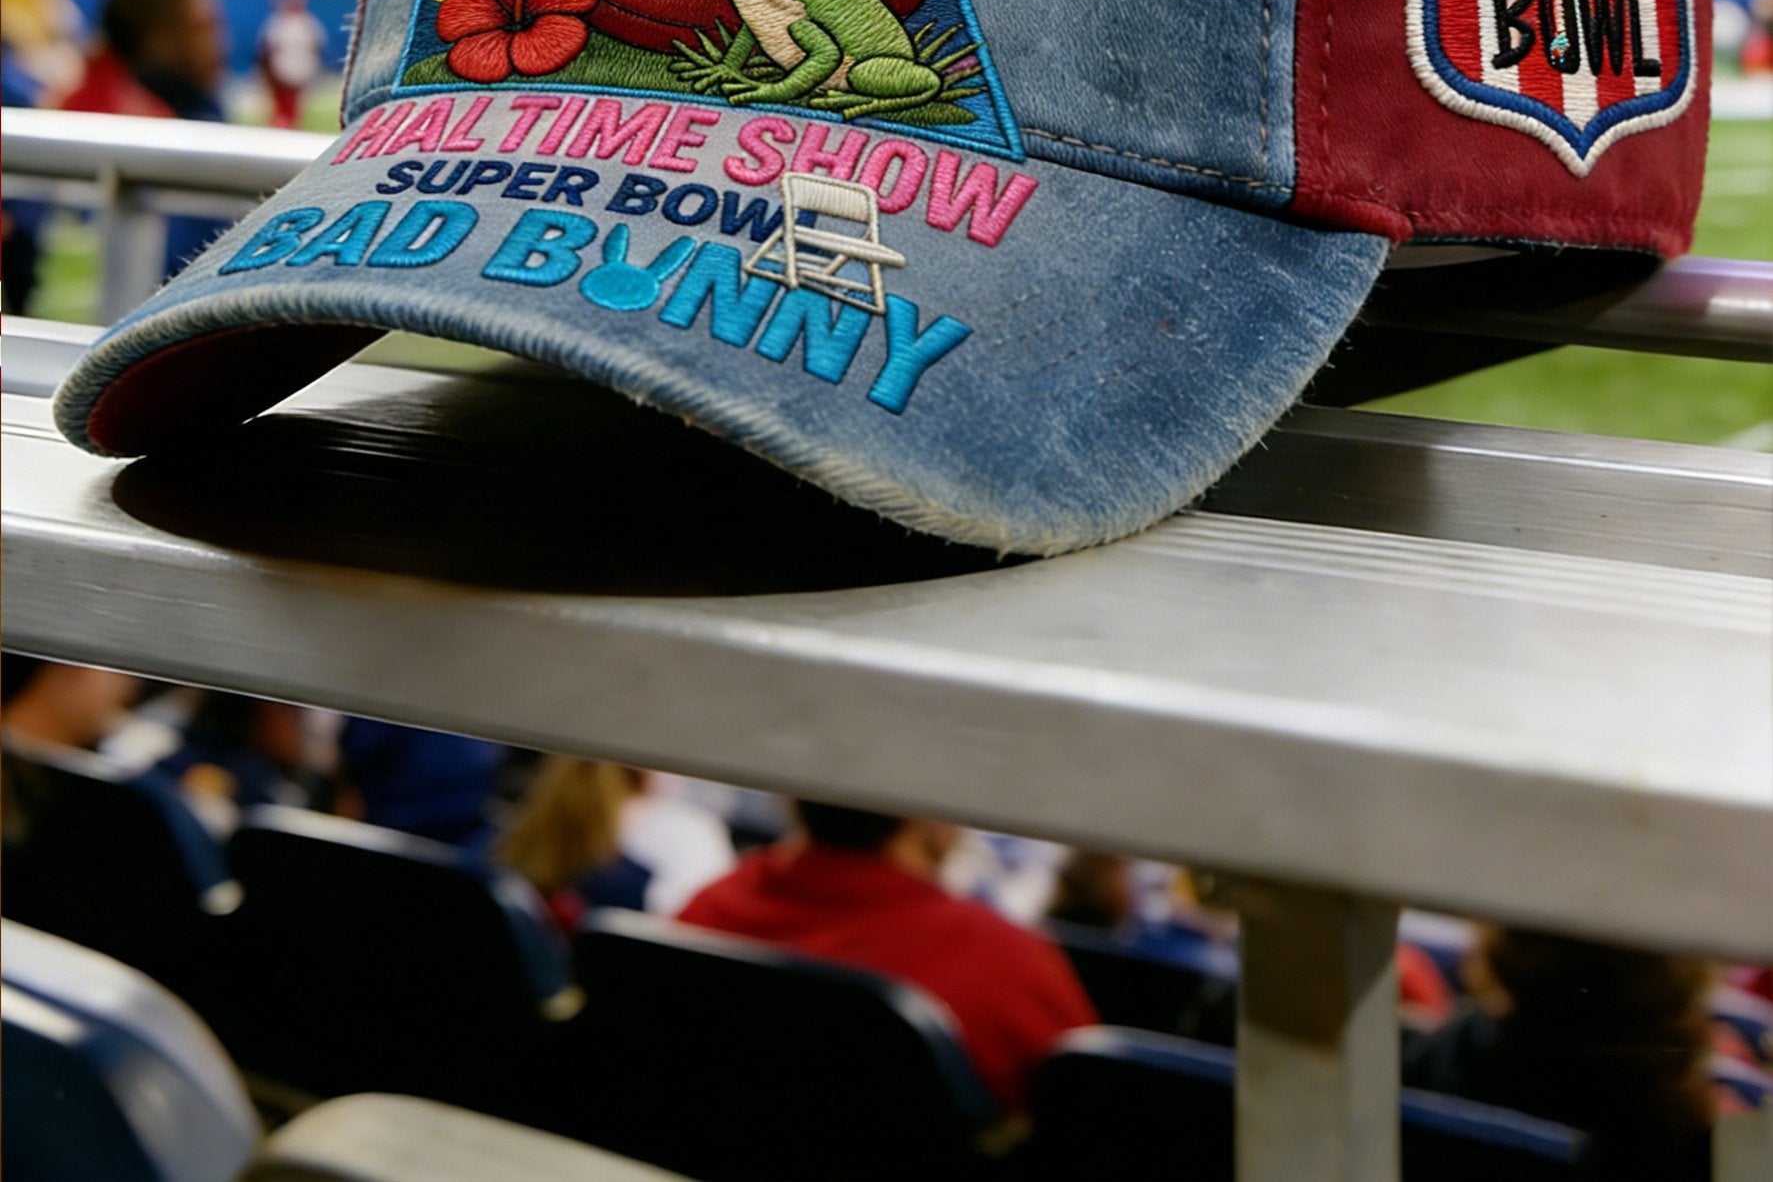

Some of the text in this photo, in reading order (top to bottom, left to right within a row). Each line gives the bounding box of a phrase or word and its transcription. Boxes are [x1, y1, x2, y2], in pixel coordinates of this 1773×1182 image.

[376, 159, 599, 207] SUPER
[723, 113, 1040, 249] SHOW
[219, 199, 478, 276] BAD
